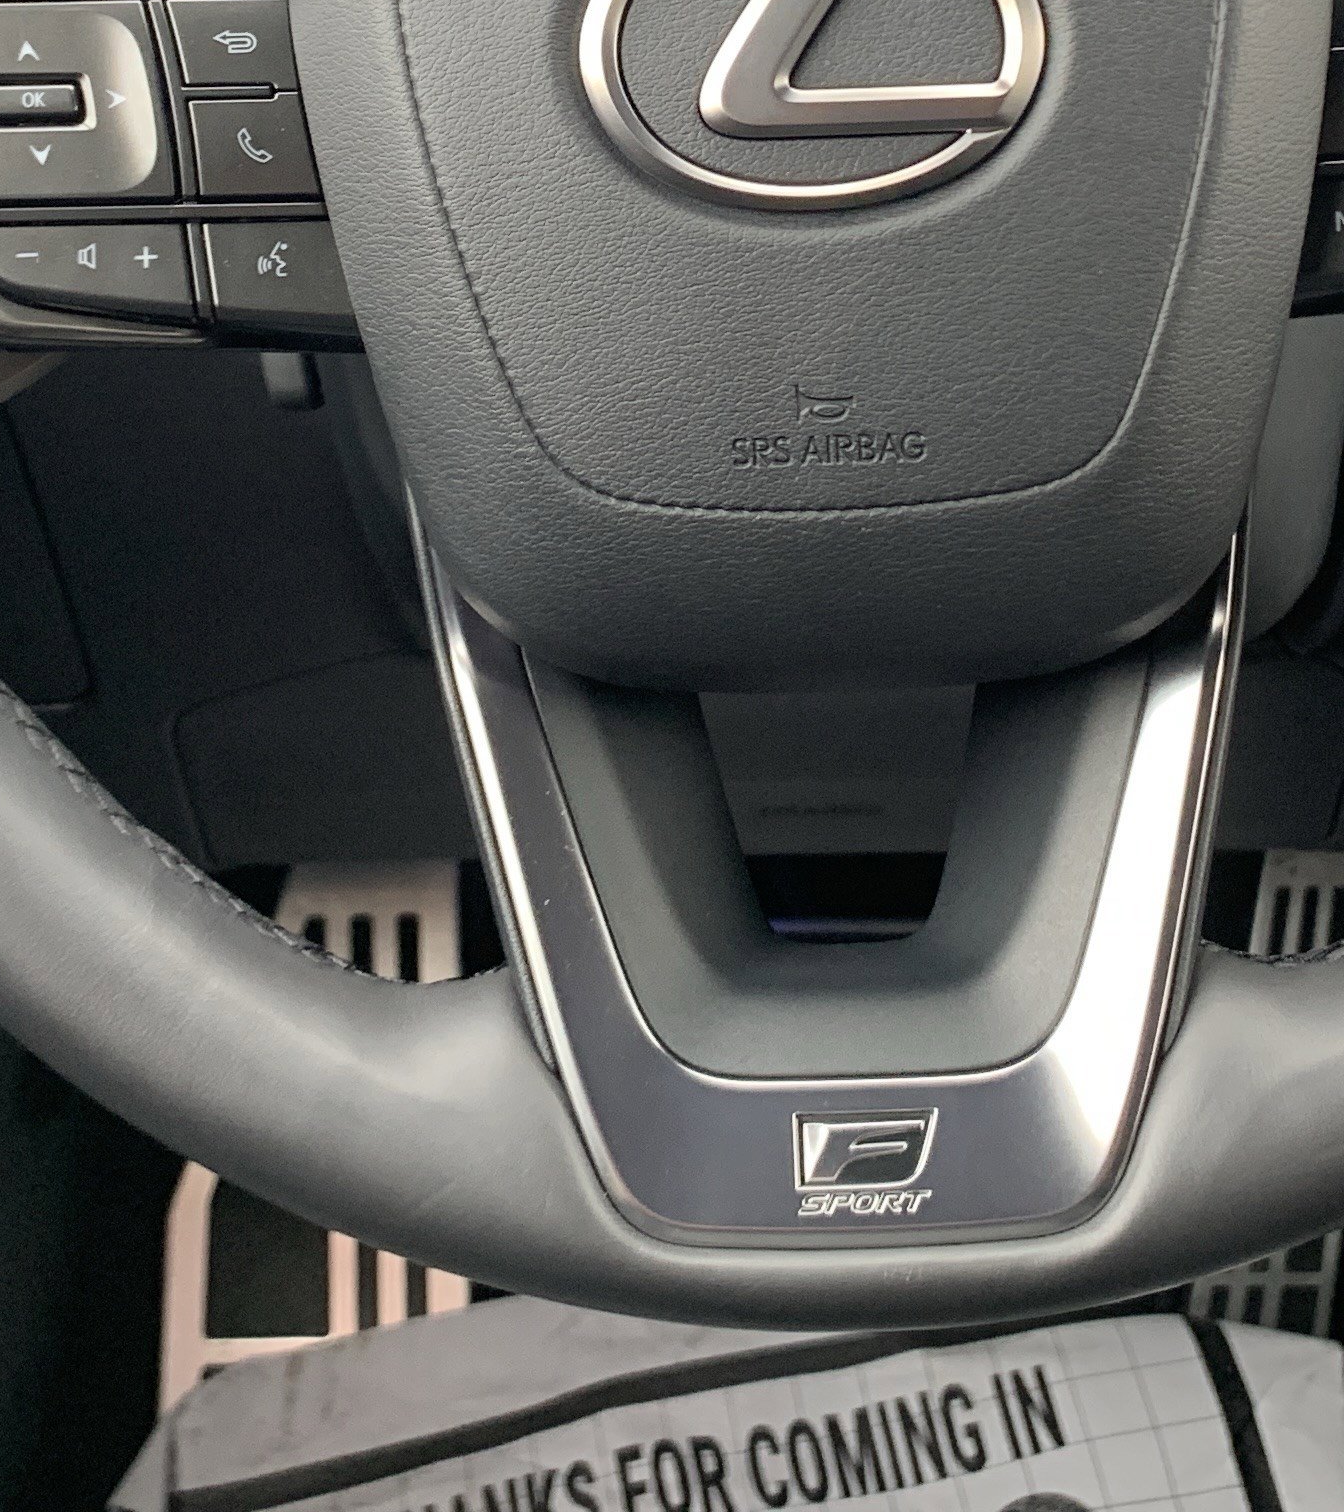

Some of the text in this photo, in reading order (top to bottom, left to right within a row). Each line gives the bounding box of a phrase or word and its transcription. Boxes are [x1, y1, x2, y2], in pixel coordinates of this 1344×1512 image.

[21, 91, 46, 109] OK
[732, 431, 927, 469] SRS AIRBAG
[797, 1189, 933, 1216] SPORT
[614, 1436, 734, 1512] FOR
[746, 1383, 987, 1510] COMING
[989, 1367, 1067, 1461] IN
